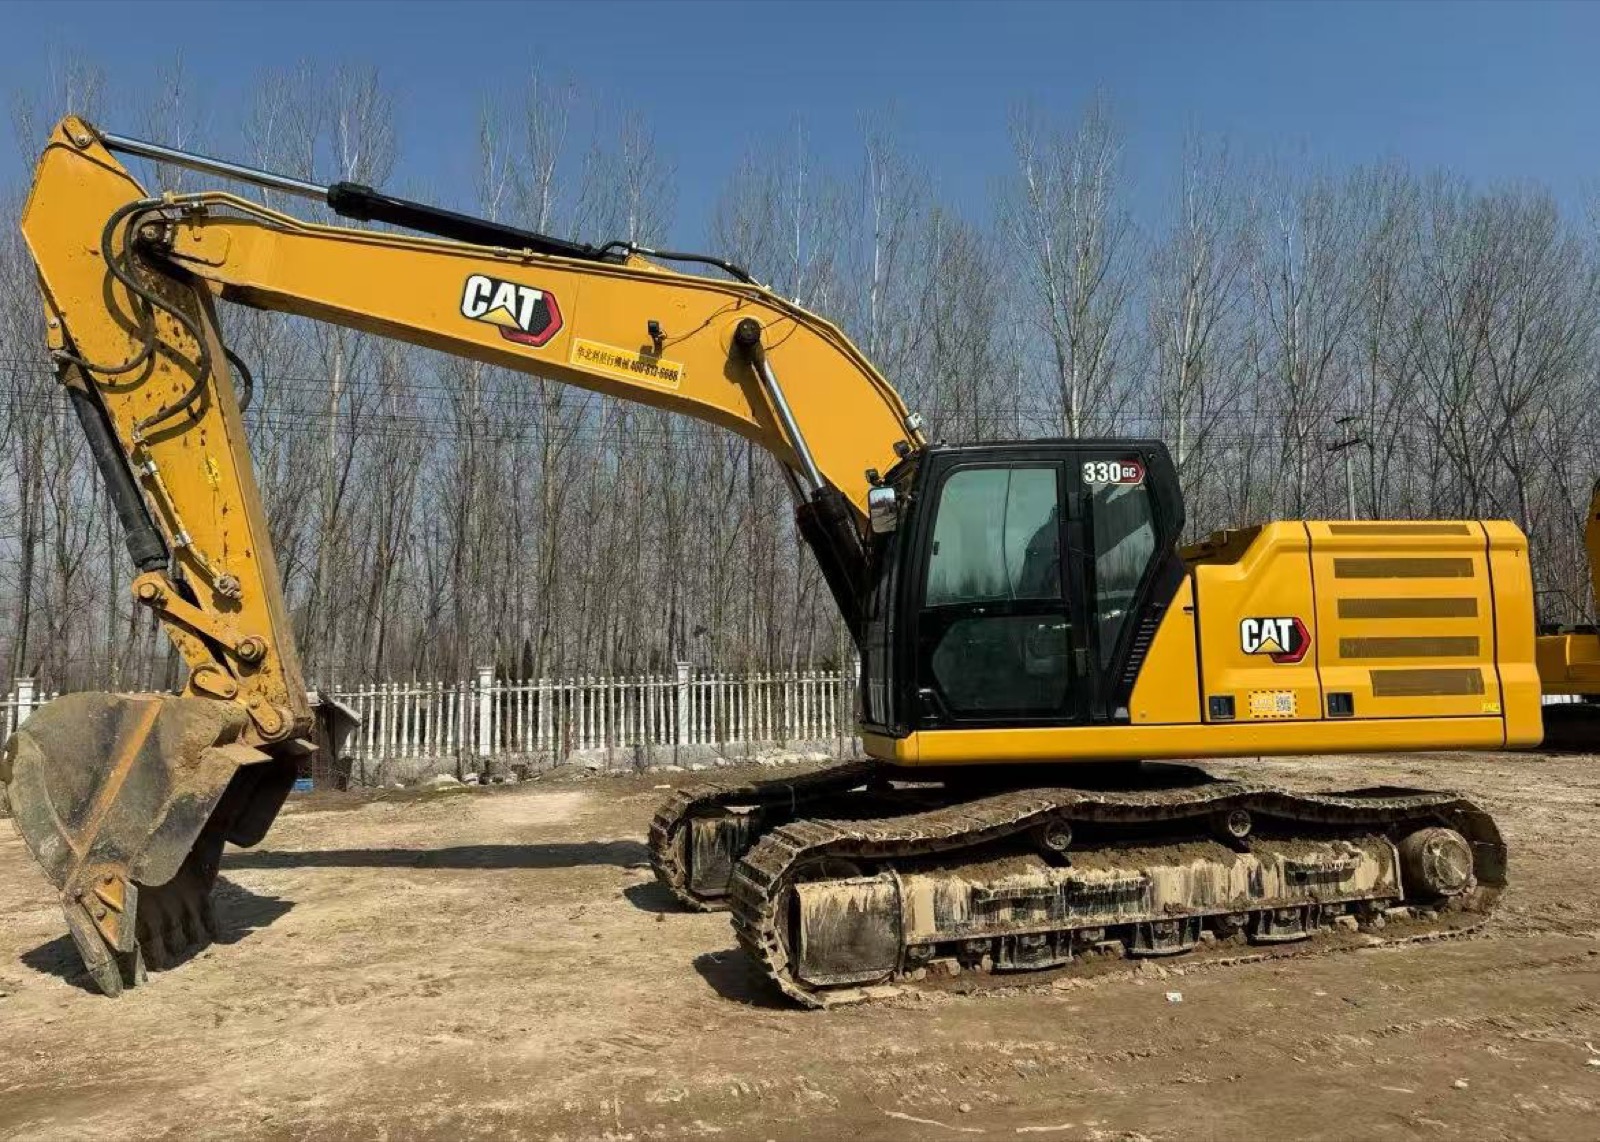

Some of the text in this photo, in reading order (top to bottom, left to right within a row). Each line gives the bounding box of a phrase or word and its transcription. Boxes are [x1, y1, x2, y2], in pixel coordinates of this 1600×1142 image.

[462, 275, 543, 332] CAT
[1084, 462, 1136, 482] 330 GC
[1241, 618, 1293, 653] CAT
